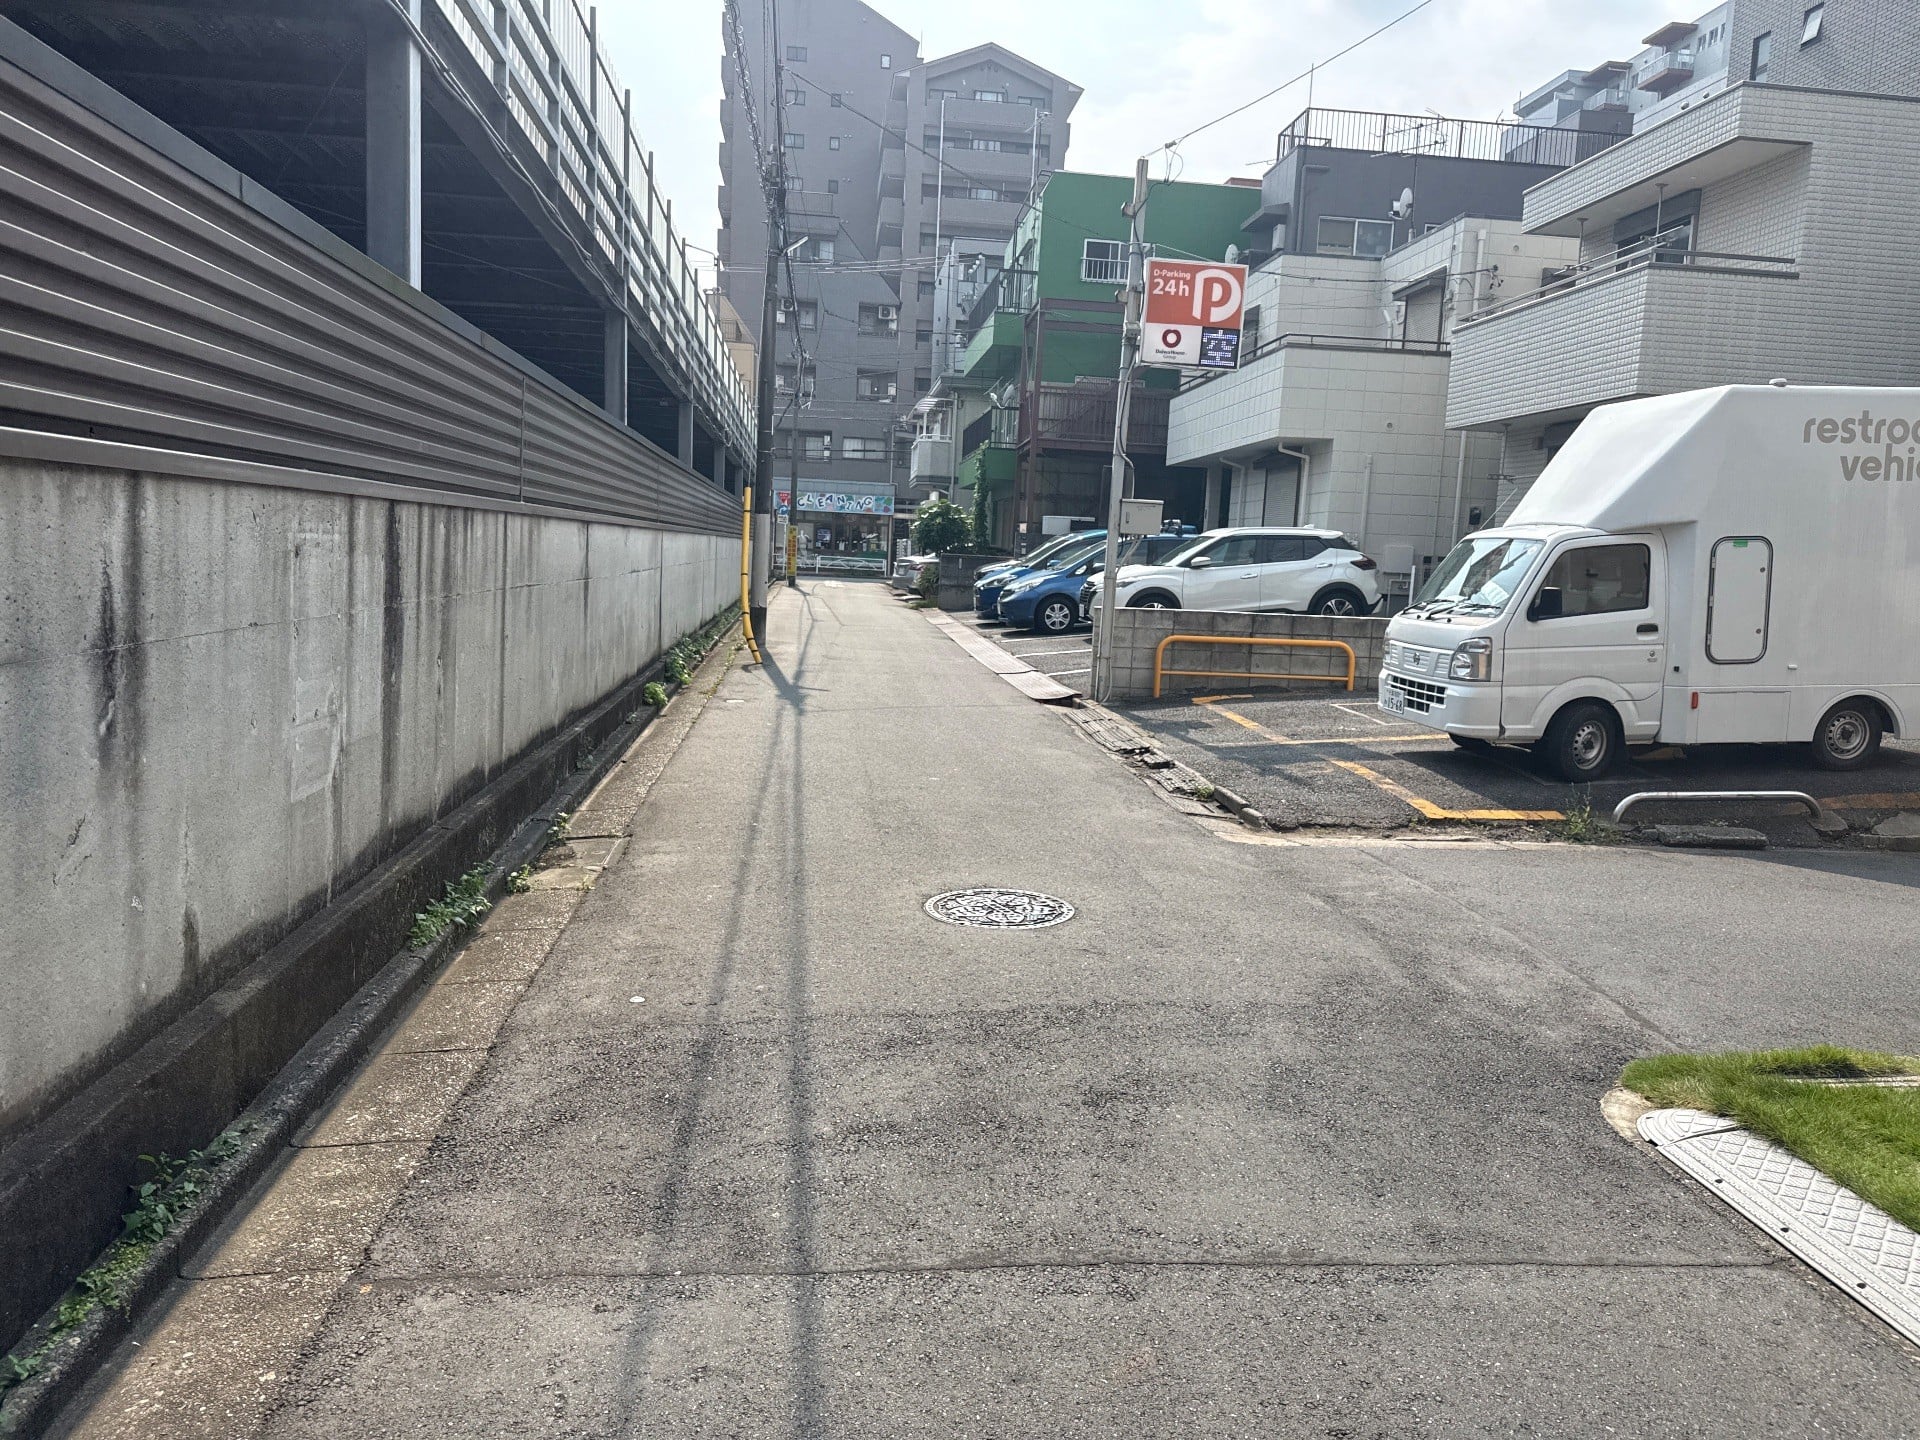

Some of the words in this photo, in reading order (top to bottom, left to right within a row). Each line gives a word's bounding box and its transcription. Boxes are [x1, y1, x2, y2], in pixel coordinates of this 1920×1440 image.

[1153, 269, 1191, 280] D-Parking
[1152, 279, 1189, 296] 24h
[1840, 443, 1920, 481] vehi
[798, 494, 873, 511] CLEANING
